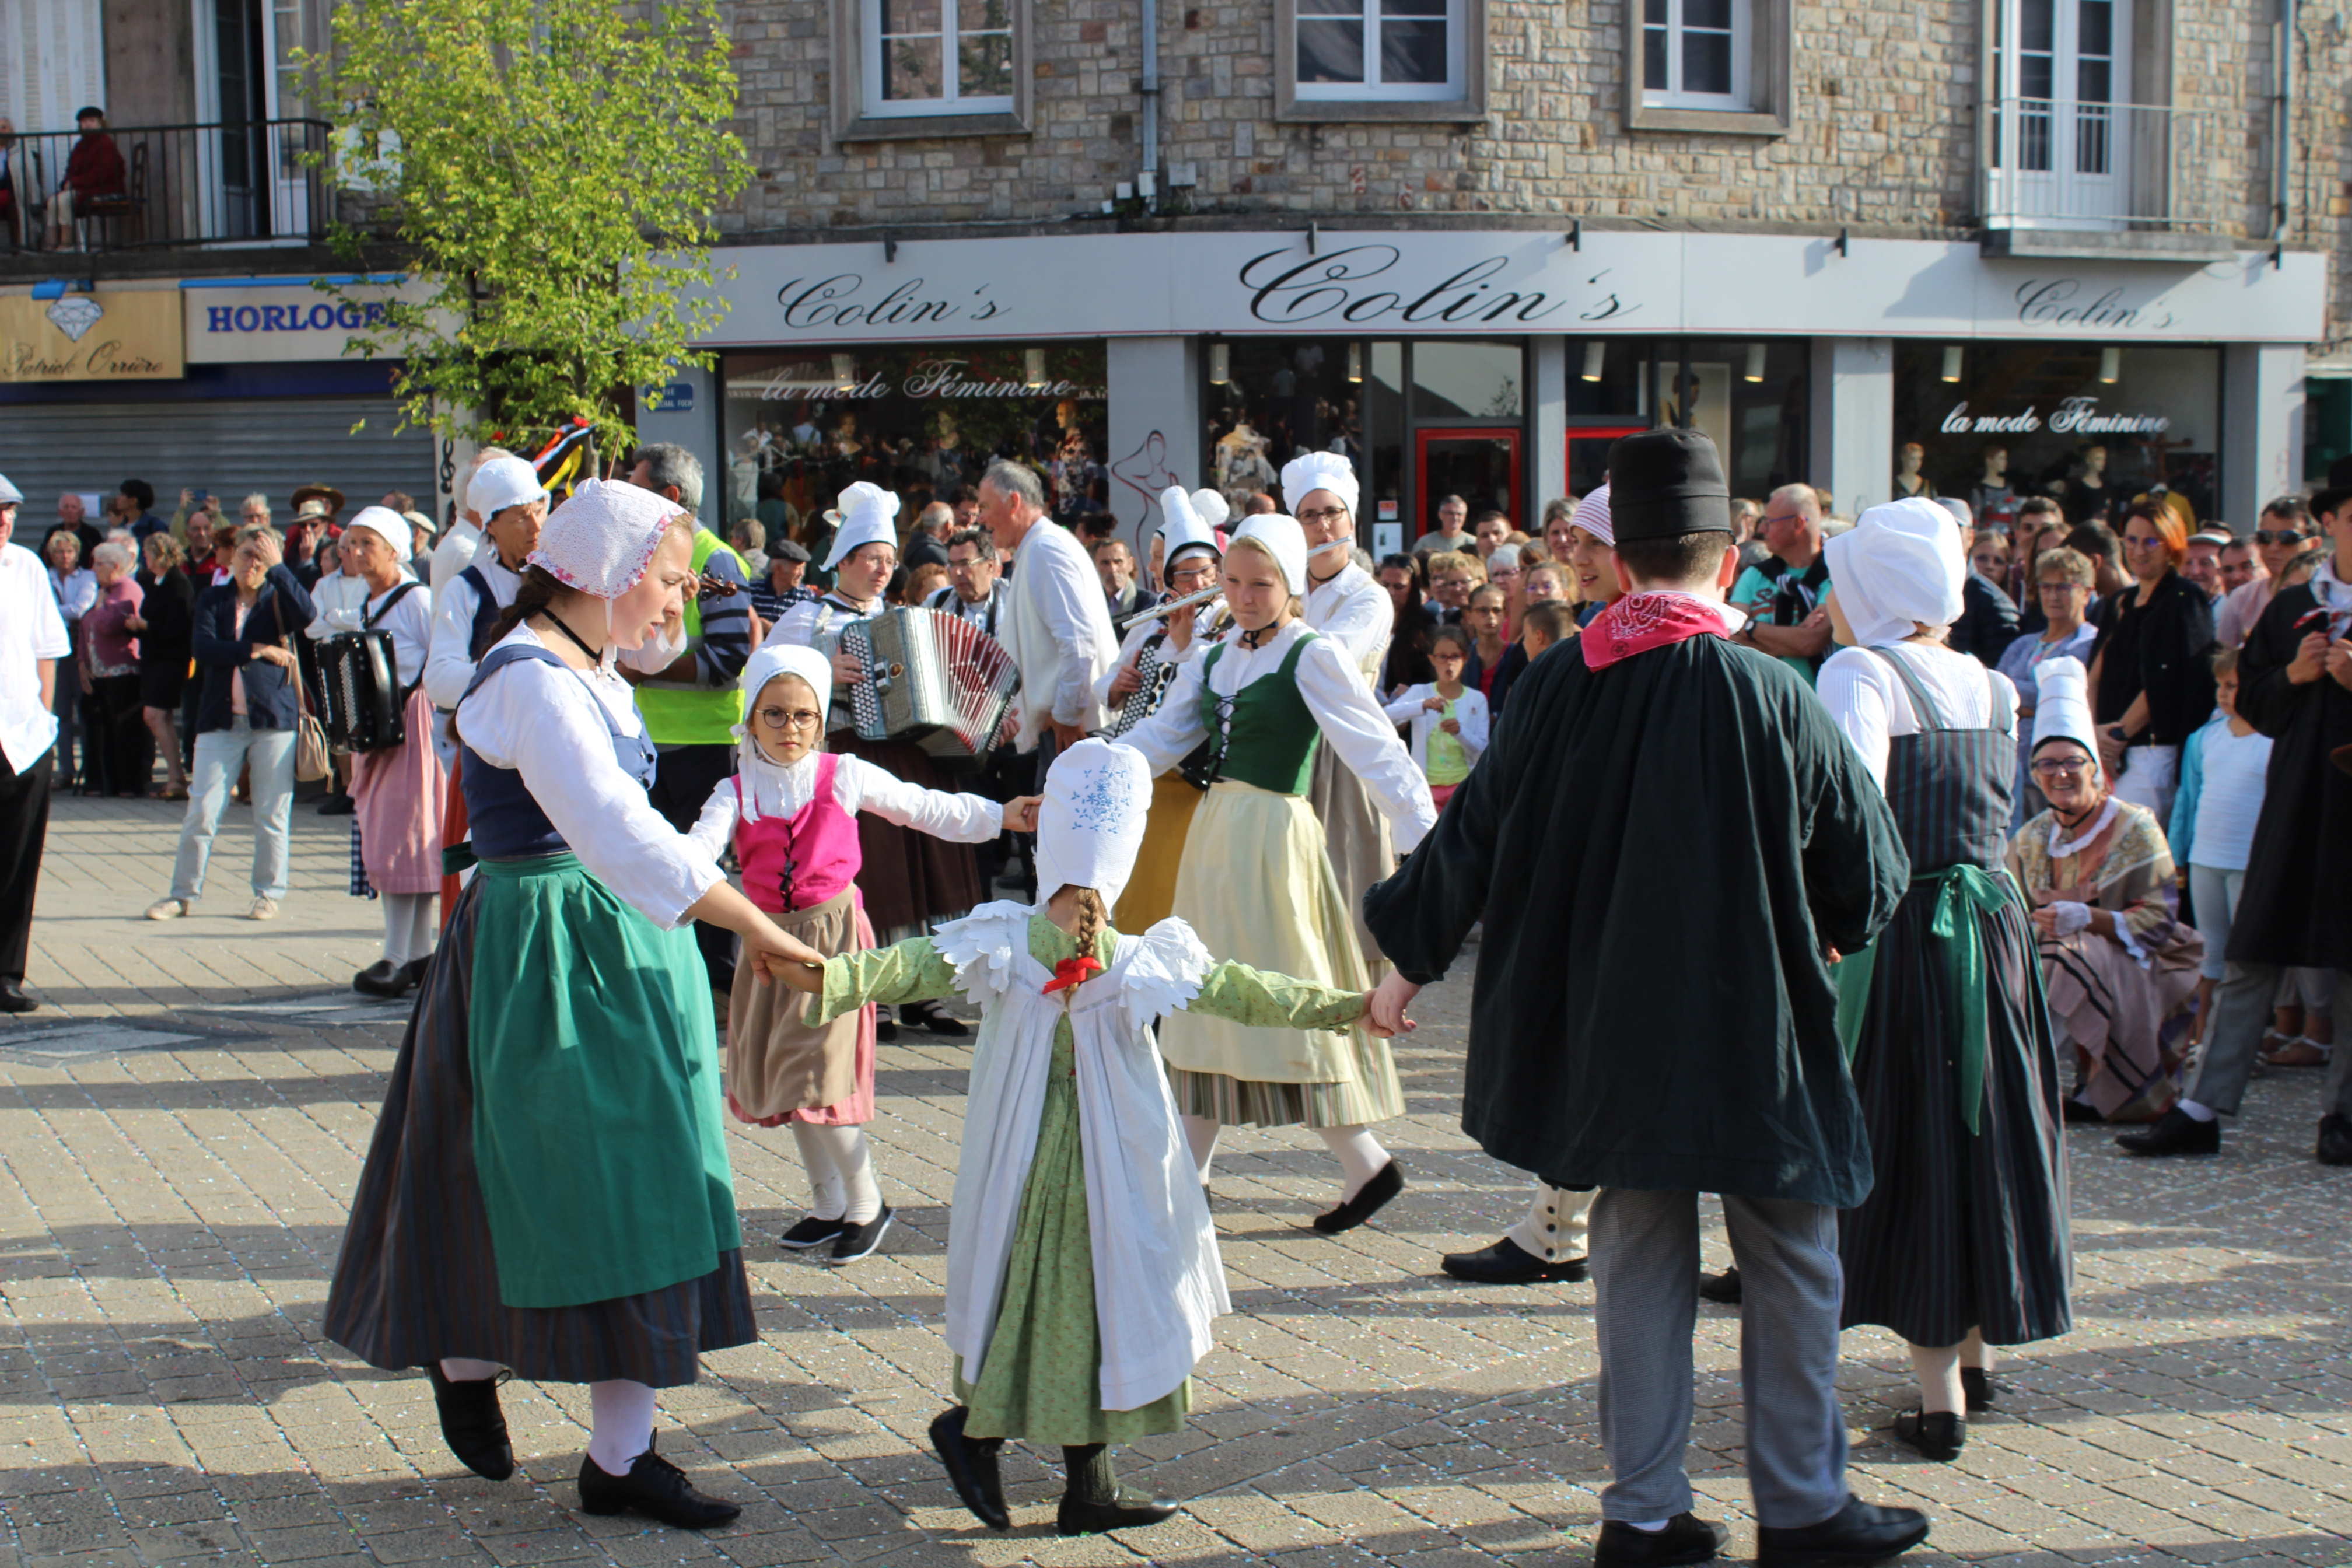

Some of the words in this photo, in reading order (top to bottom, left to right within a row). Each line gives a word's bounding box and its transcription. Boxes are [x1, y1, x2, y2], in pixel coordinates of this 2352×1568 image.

[778, 274, 1012, 328] Colin's
[1239, 245, 1643, 323] Colin's
[2015, 278, 2183, 328] Colin's
[3, 341, 84, 376] Patrick
[761, 368, 800, 400] la
[803, 371, 891, 400] mode
[903, 359, 1077, 398] Féminine
[1941, 401, 1973, 433] la
[1973, 405, 2042, 433] mode
[2049, 396, 2171, 433] Féminine
